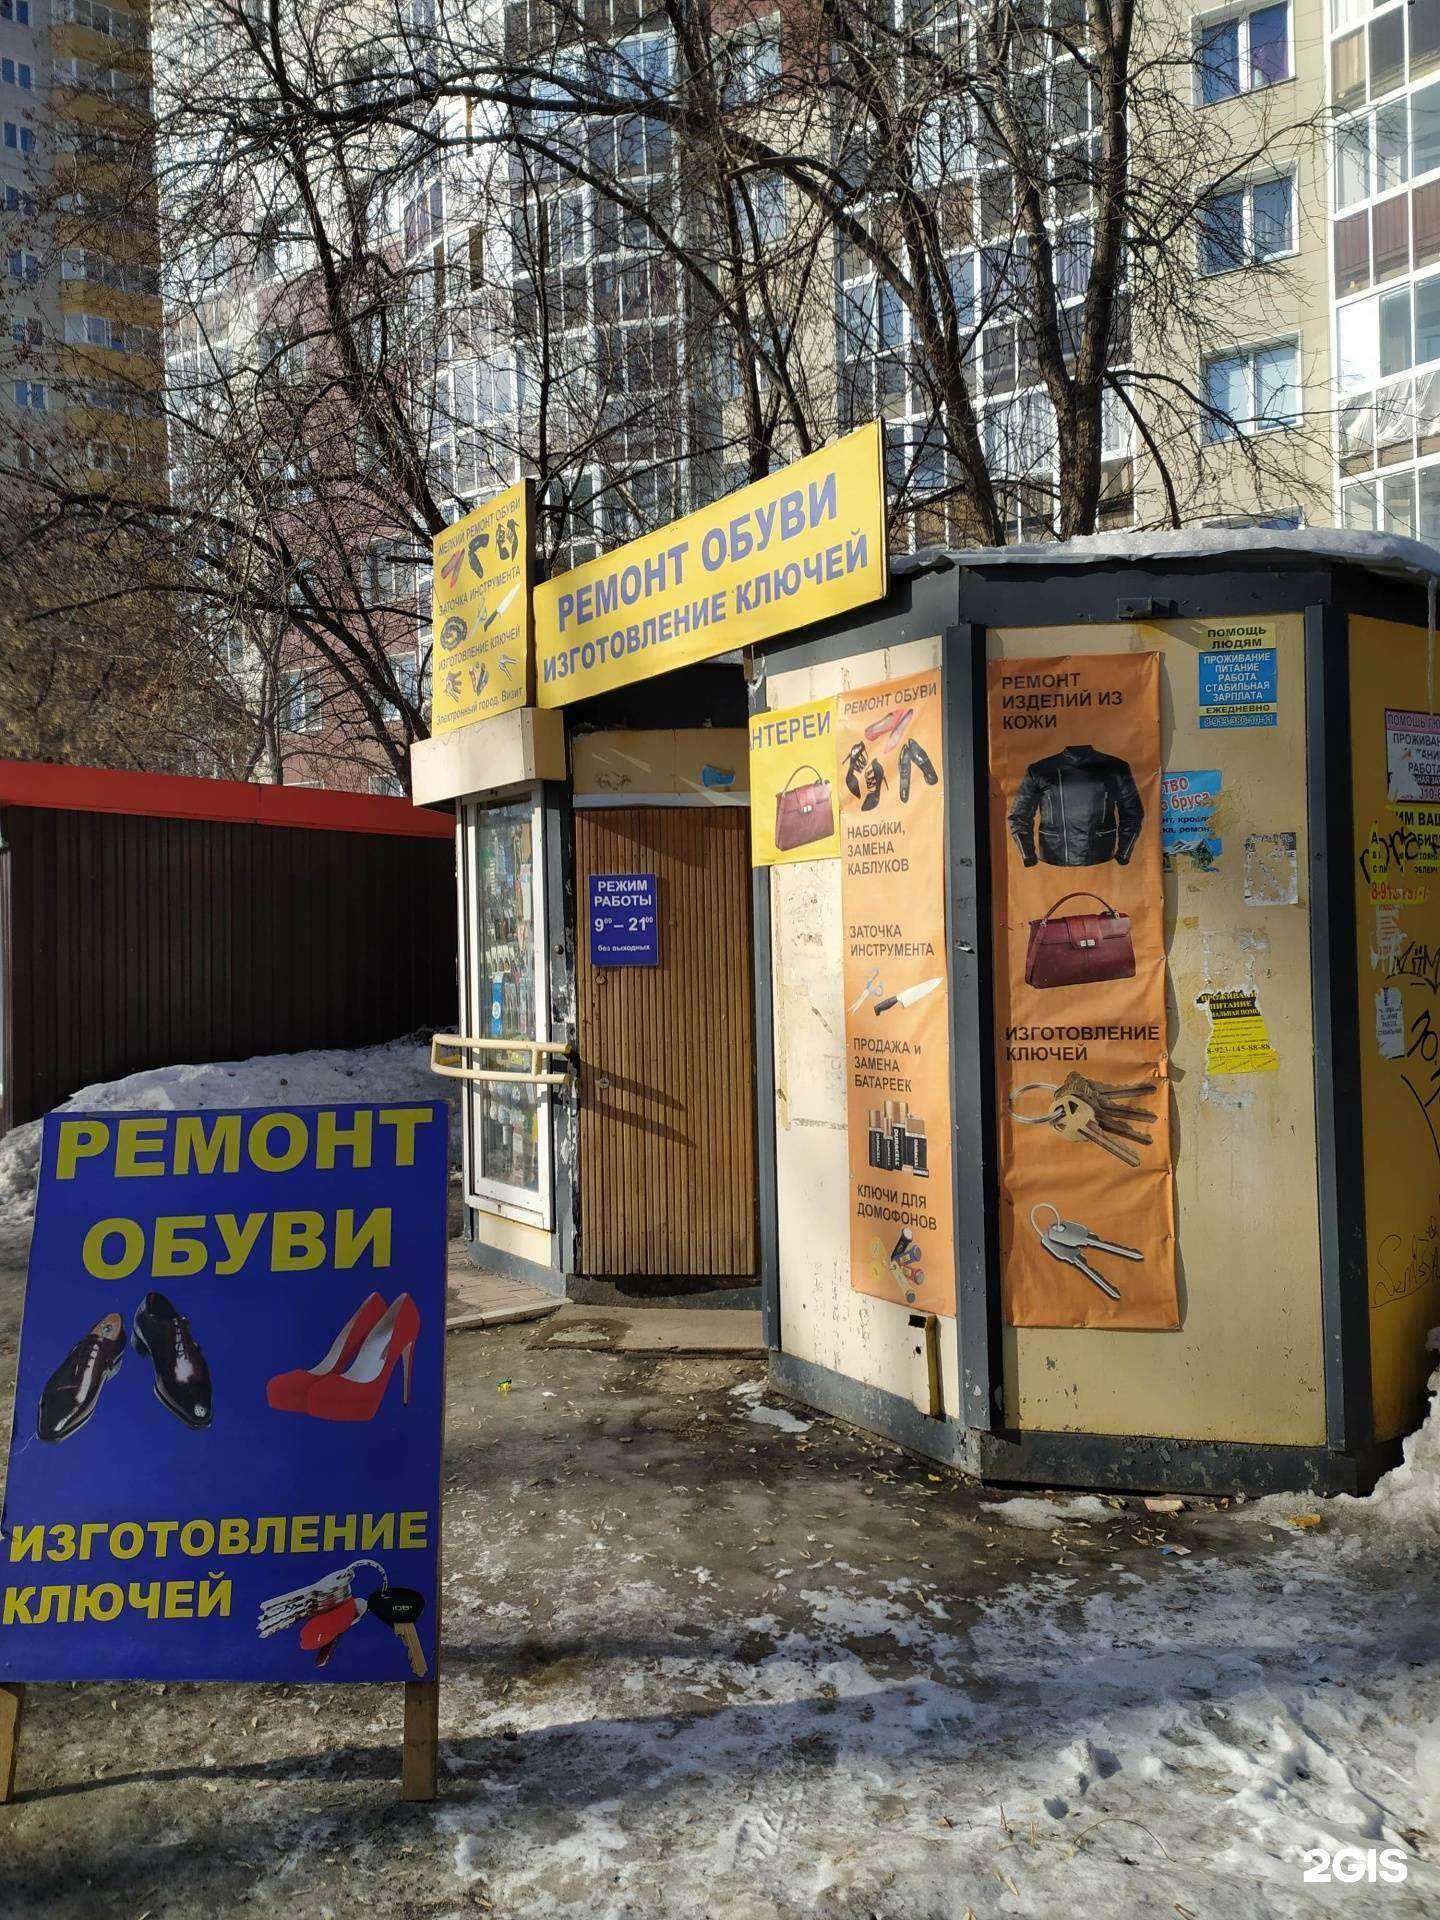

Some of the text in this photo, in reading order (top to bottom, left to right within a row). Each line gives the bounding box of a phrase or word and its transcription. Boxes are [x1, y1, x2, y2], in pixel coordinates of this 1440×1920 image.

[438, 499, 521, 556] МЕЛКИЙ РЕМОНТ ОБУВИ
[557, 472, 838, 633] РЕМОНТ ОБУВИ
[438, 571, 521, 617] ЗАТОЧКА ИНСТРУМЕНТА
[543, 529, 869, 684] ИЗГОТОВЛЕНИЕ КЛЮЧЕЙ
[1207, 626, 1267, 638] ПОМОЩЬ
[438, 625, 521, 672] ИЗГОТОВЛЕНИЕ КЛЮЧЕЙ
[1212, 638, 1262, 649] ЛЮДЯМ
[1204, 652, 1271, 664] ПРОЖИВАНИЕ
[1215, 662, 1260, 673] ПИТАНИЕ
[1002, 673, 1080, 689] РЕМОНТ
[1218, 672, 1257, 682] РАБОТА
[1205, 681, 1270, 693] СТАБИЛЬНАЯ
[844, 682, 937, 715] РЕМОНТ ОБУВИ
[1003, 690, 1123, 711] ИЗДЕЛИЙ ИЗ
[1213, 691, 1263, 702] ЗАРПЛАТА
[436, 702, 477, 726] Электронный
[501, 687, 524, 703] Визит
[1206, 704, 1271, 714] ЕЖЕДНЕВНО
[1003, 715, 1057, 730] КОЖИ
[1387, 714, 1426, 729] ПОМОЩЬ
[847, 820, 906, 839] НАБОЙКИ,
[847, 841, 894, 857] ЗАМЕНА
[848, 858, 909, 876] КАБЛУКОВ
[597, 880, 648, 892] РЕЖИМ
[594, 895, 652, 907] РАБОТЫ
[850, 924, 902, 939] ЗАТОЧКА
[597, 944, 611, 952] без
[850, 943, 935, 957] ИНСТРУМЕНТА
[1005, 1026, 1159, 1041] ИЗГОТОВЛЕНИЕ
[853, 1037, 911, 1055] ПРОДАЖА
[1006, 1044, 1088, 1061] КЛЮЧЕЙ
[854, 1056, 900, 1072] ЗАМЕНА
[854, 1074, 912, 1092] БАТАРЕЕК
[55, 1107, 435, 1181] РЕМОНТ
[857, 1184, 927, 1209] КЛЮЧИ ДЛЯ
[857, 1202, 937, 1230] ДОМОФОНОВ
[81, 1206, 393, 1280] ОБУВИ
[8, 1510, 429, 1563] ИЗГОТОВЛЕНИЕ
[1, 1571, 232, 1625] КЛЮЧЕЙ
